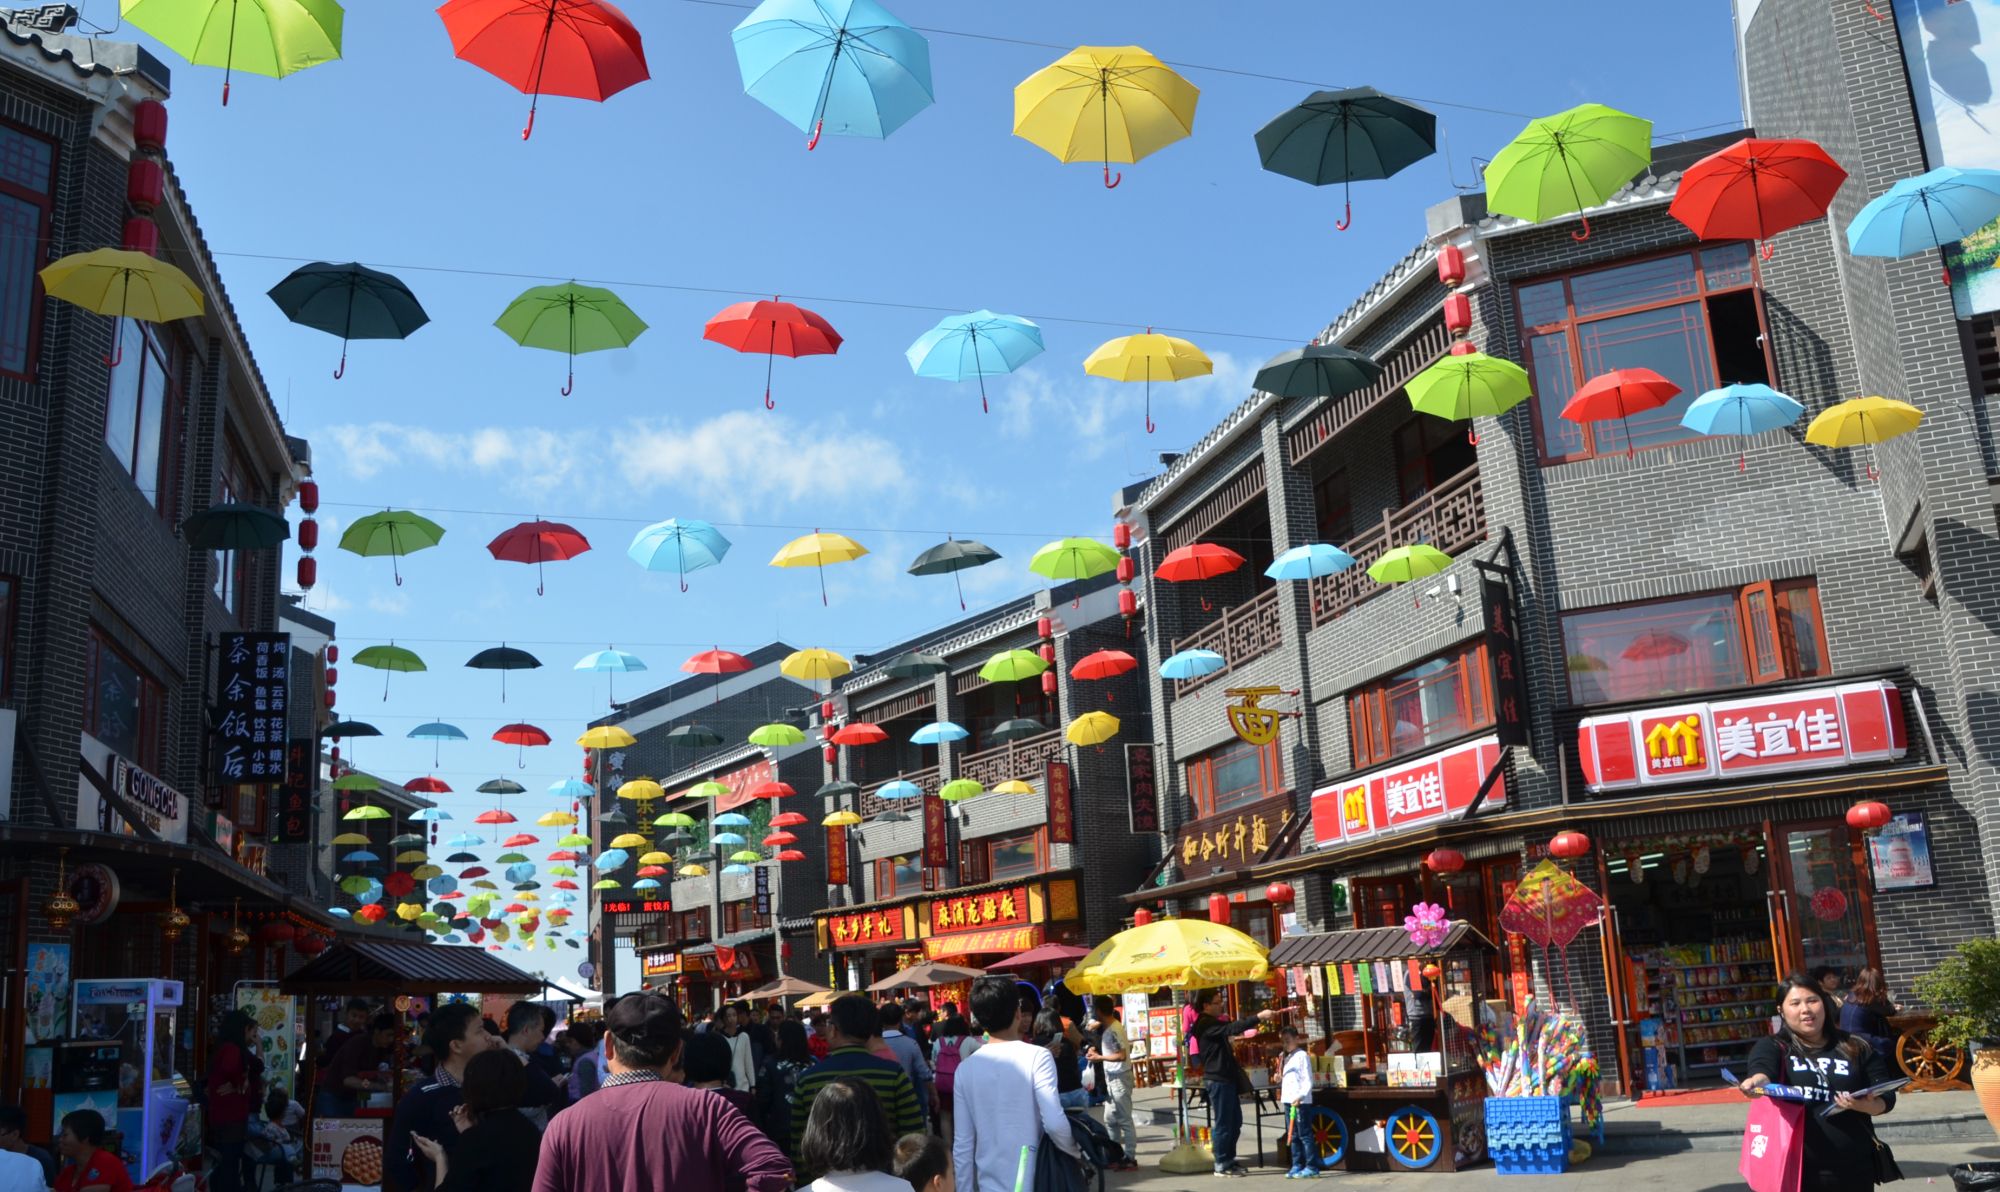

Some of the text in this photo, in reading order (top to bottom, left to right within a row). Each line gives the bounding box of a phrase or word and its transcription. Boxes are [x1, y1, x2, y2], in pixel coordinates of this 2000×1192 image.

[1492, 603, 1518, 724] 美宜佳
[1717, 708, 1841, 761] 美宜佳
[1651, 755, 1684, 770] 美宜佳
[131, 767, 160, 810] GONG
[160, 787, 178, 820] CHA
[1386, 770, 1442, 818] 美宜佳
[836, 913, 892, 942] 水乡手礼
